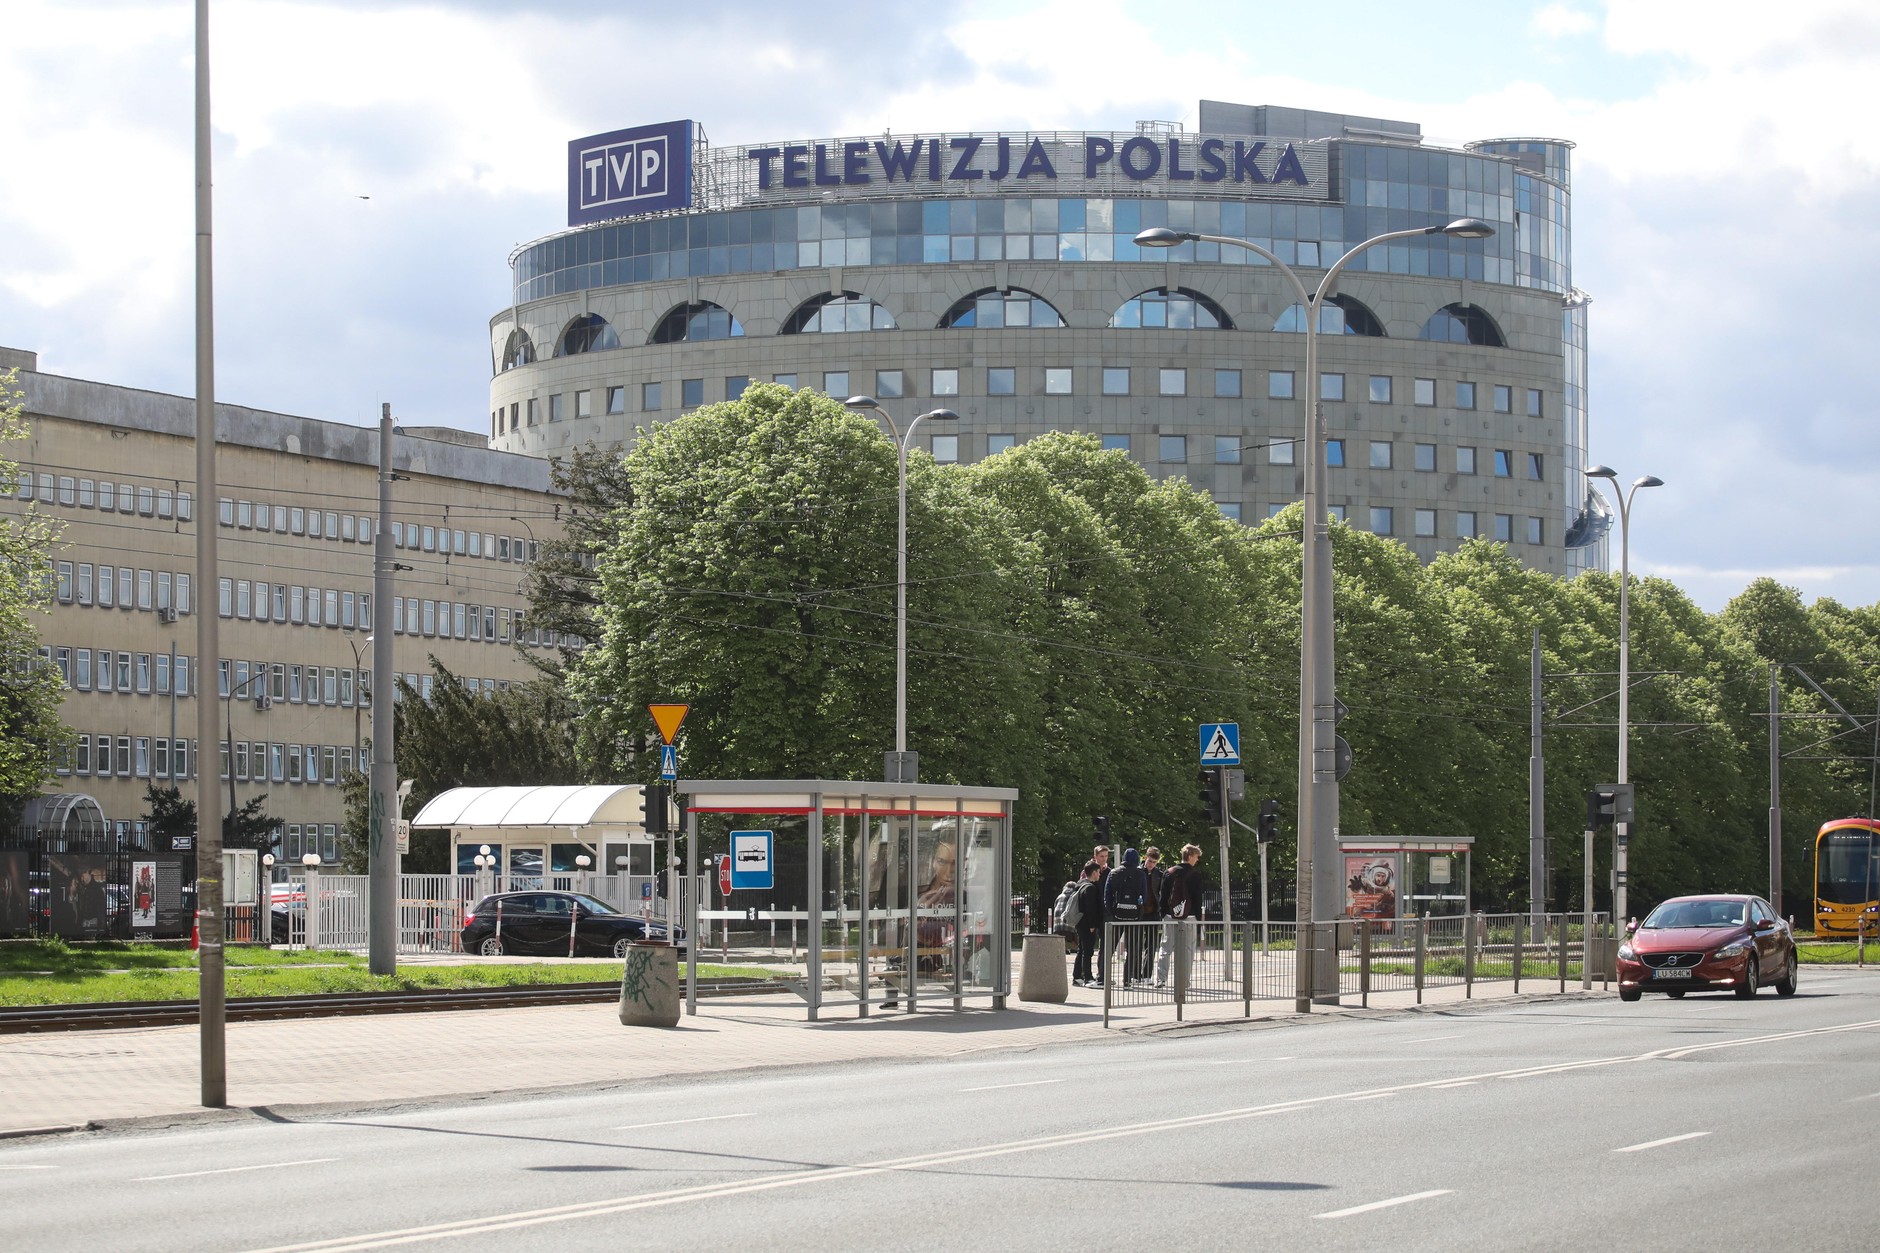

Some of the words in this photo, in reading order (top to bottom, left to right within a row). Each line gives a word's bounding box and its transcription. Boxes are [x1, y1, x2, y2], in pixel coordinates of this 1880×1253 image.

[585, 149, 660, 197] TVP
[749, 136, 1058, 190] TELEWIZJA
[1086, 136, 1309, 186] POLSKA
[398, 825, 407, 835] 20
[720, 869, 730, 882] STO
